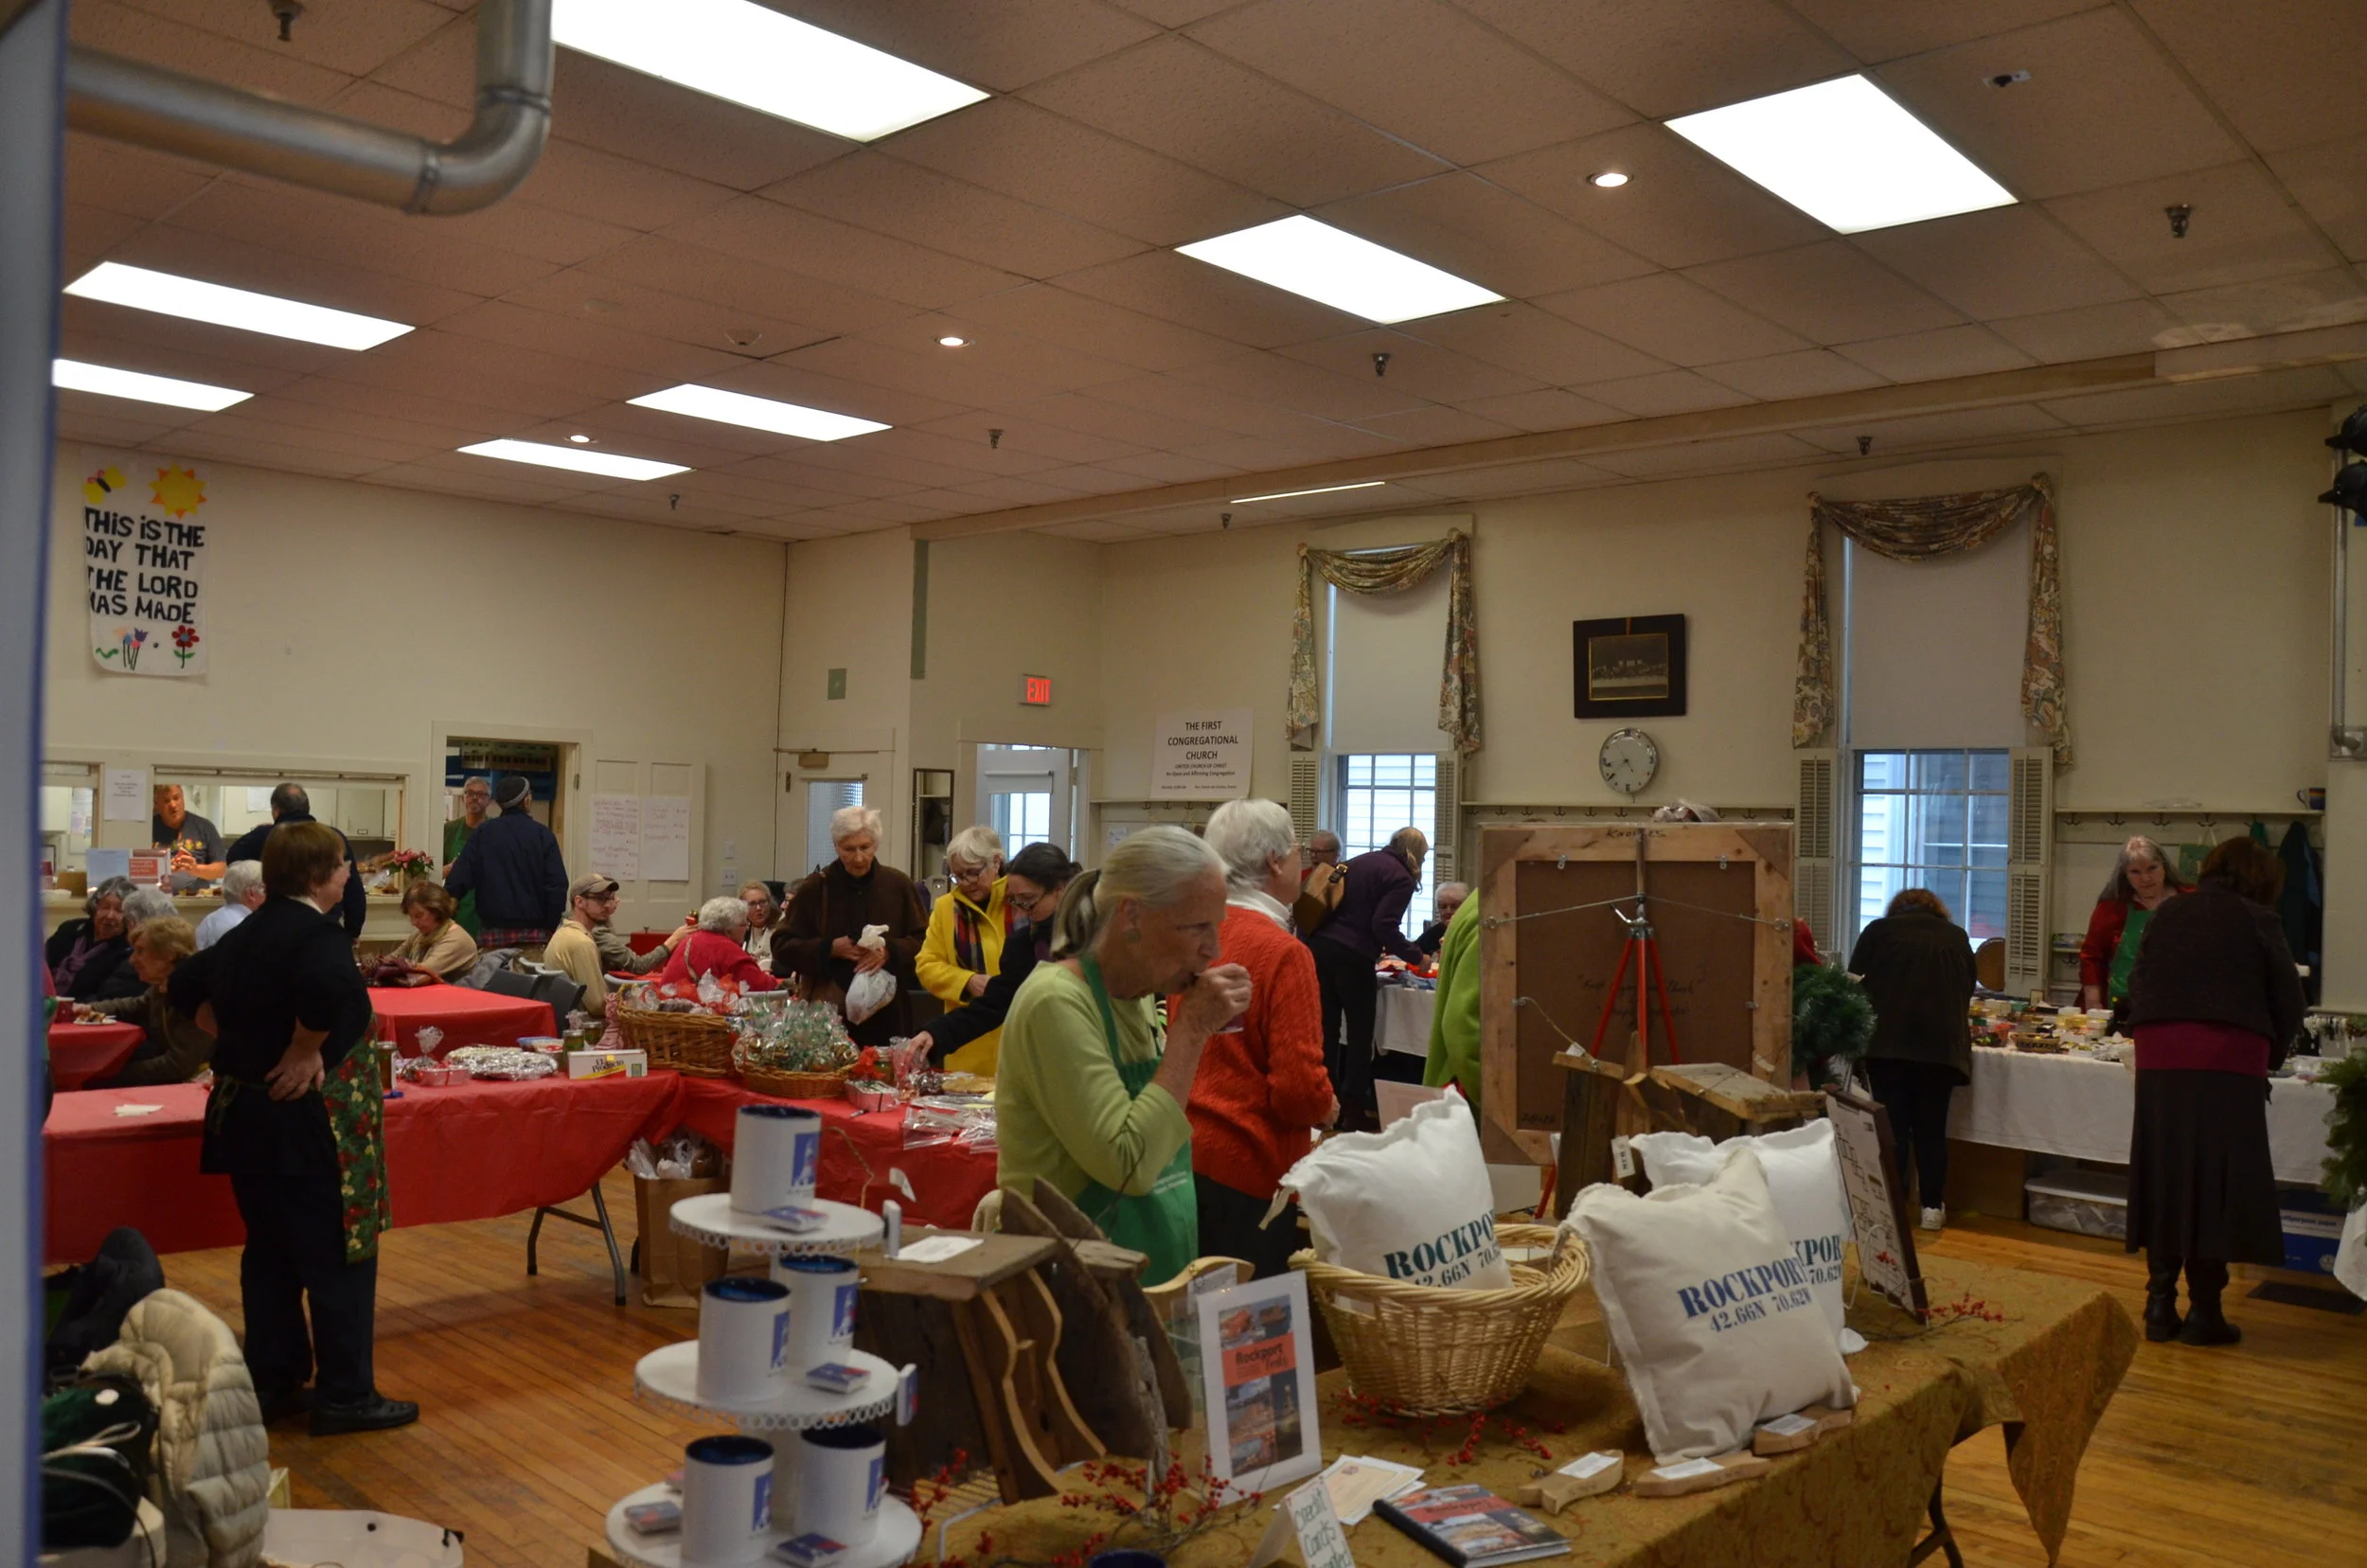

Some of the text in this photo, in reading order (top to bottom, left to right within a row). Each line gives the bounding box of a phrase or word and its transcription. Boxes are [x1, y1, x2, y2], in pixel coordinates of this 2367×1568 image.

[164, 521, 205, 547] THE
[86, 535, 194, 570] DAY THAT
[138, 572, 198, 598] LORD
[135, 596, 195, 624] MADE
[1027, 678, 1052, 703] EXIT
[1185, 721, 1222, 731] THE FIRST
[1167, 735, 1238, 746] CONGREGATIONAL
[1185, 751, 1218, 759] CHURCH
[1383, 1209, 1494, 1279] ROCKPO
[1711, 1301, 1767, 1332] 42.66N
